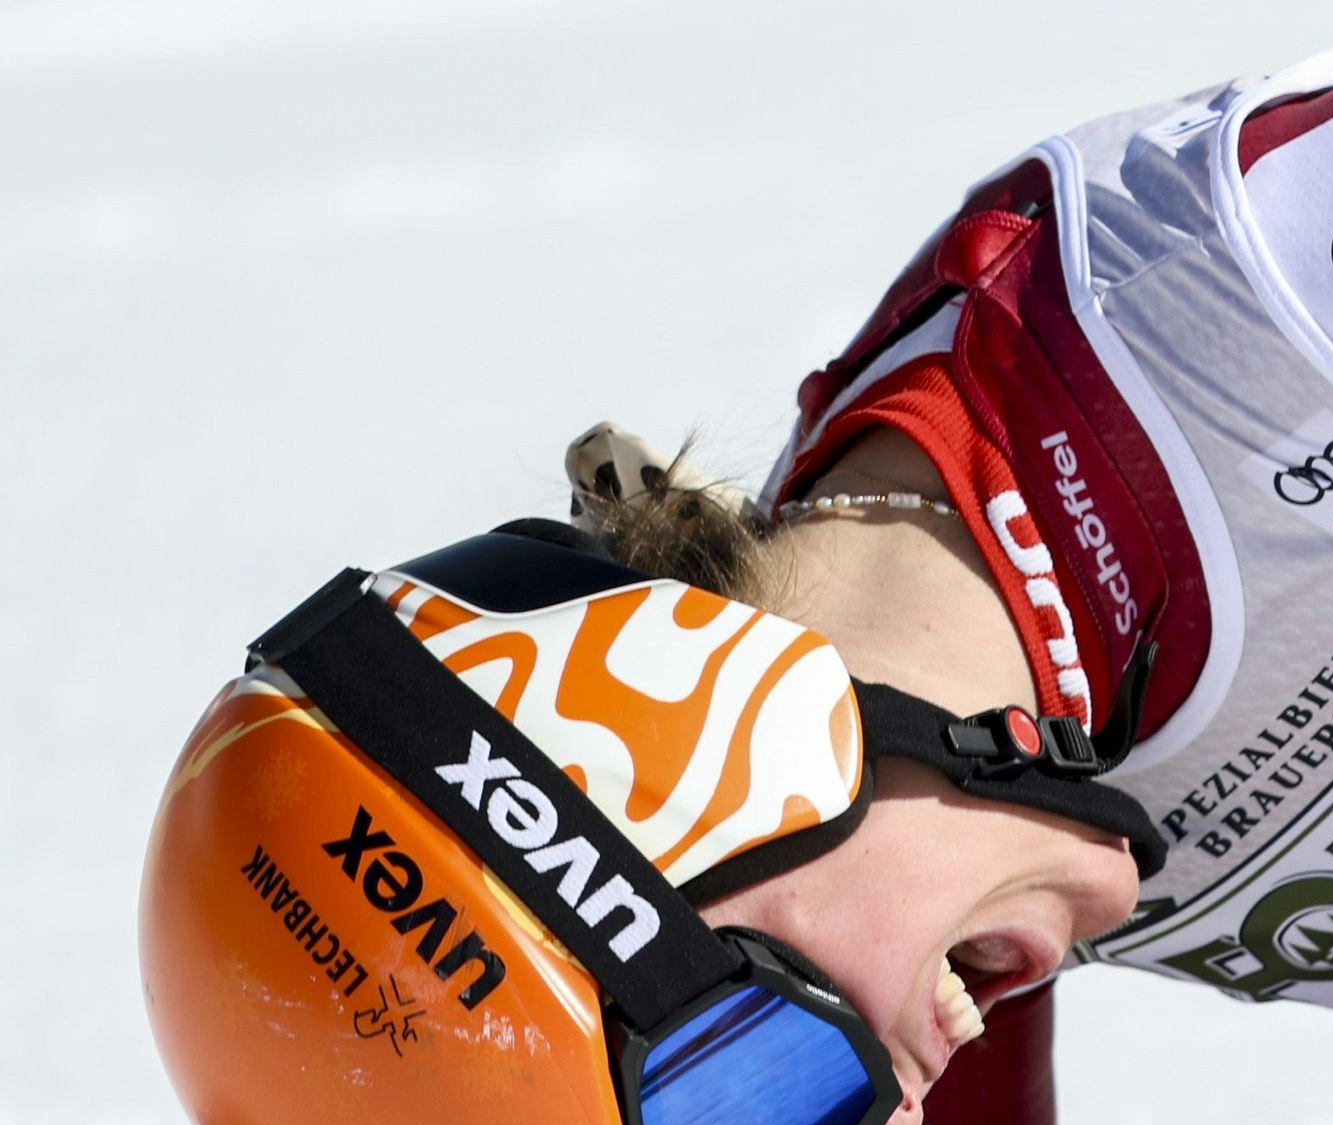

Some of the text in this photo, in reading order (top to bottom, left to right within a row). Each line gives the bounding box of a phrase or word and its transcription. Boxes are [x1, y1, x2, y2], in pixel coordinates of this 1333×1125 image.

[240, 844, 368, 998] LECHBANK
[321, 805, 507, 1011] uvex
[434, 730, 660, 963] uvex
